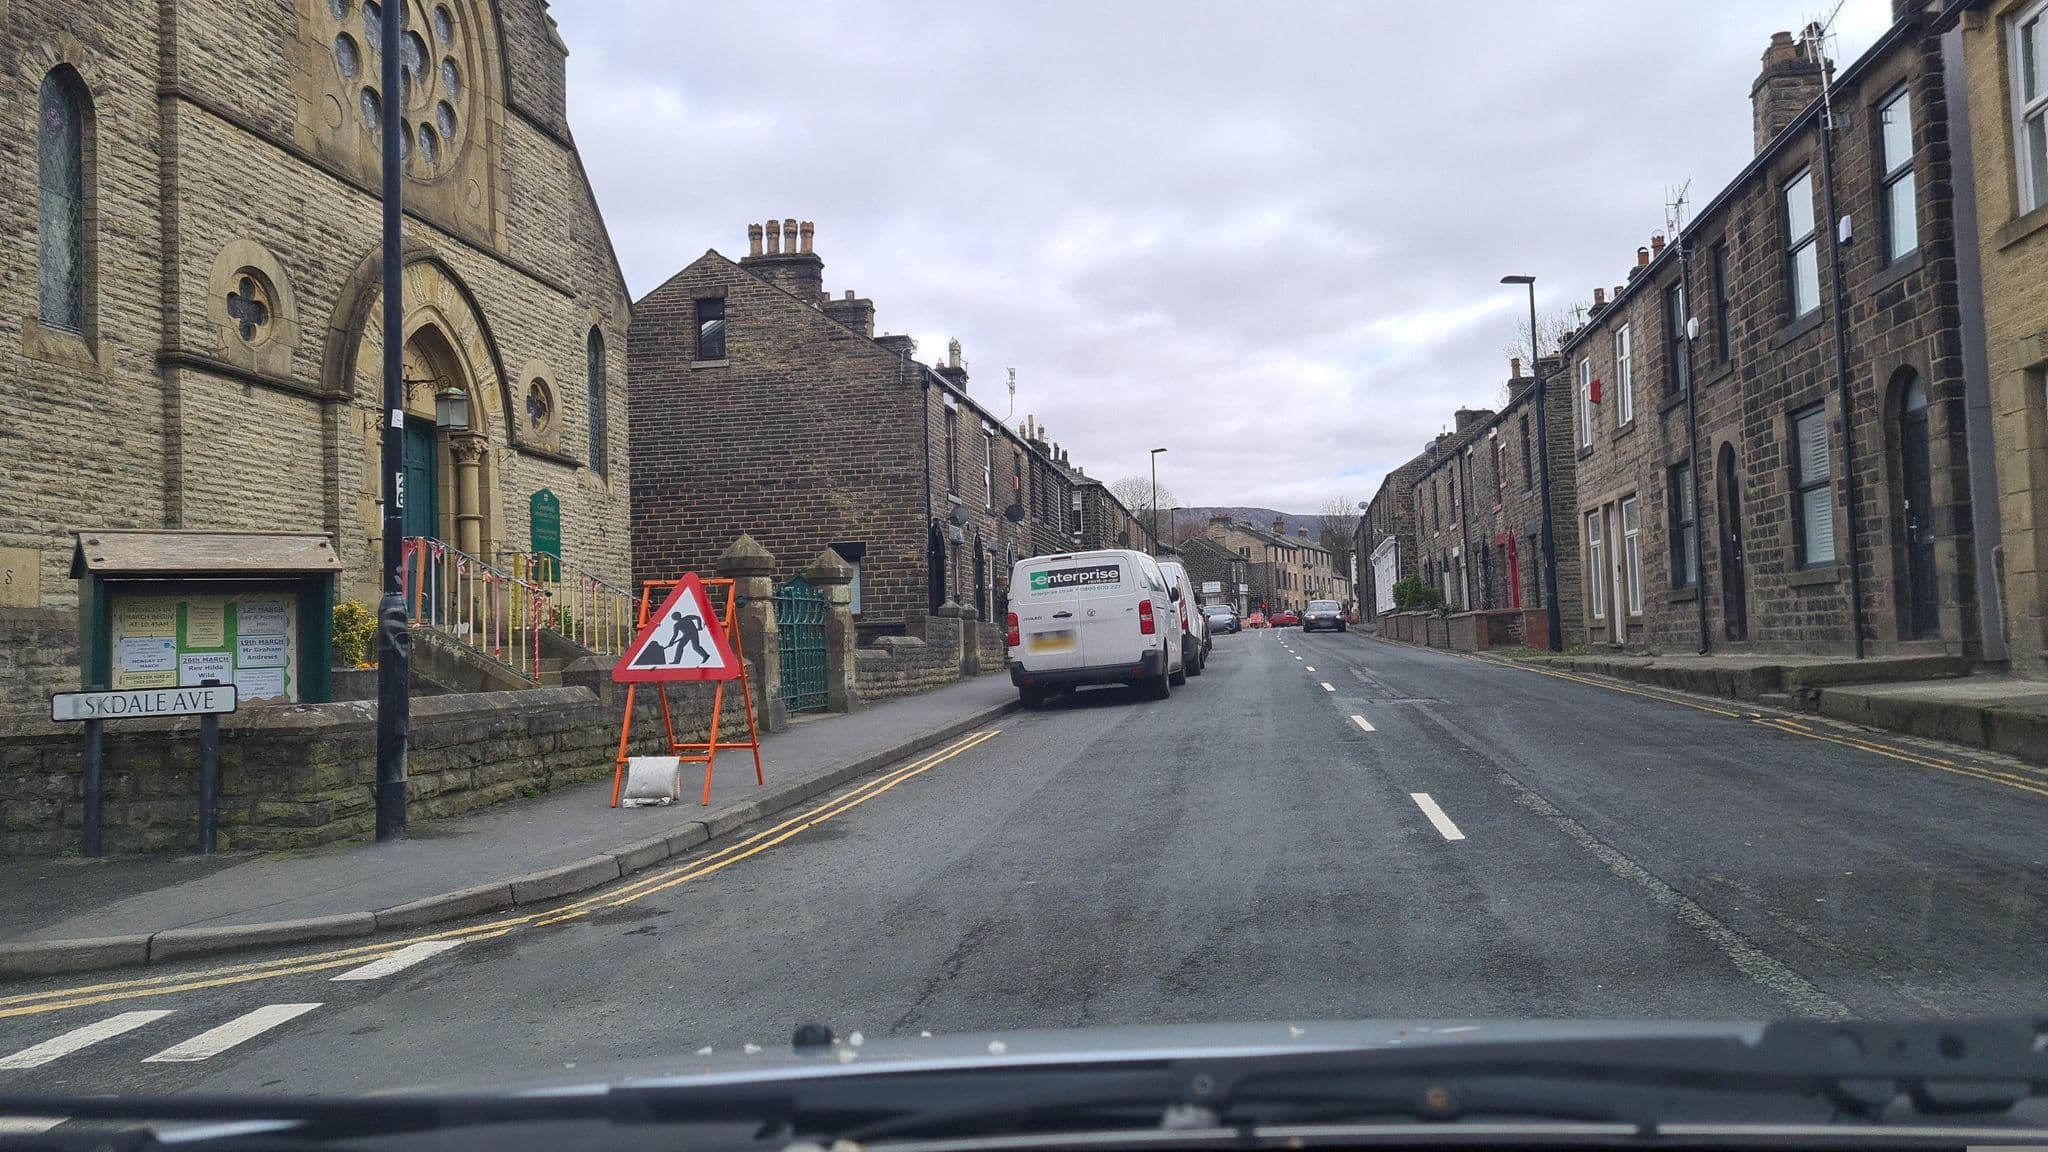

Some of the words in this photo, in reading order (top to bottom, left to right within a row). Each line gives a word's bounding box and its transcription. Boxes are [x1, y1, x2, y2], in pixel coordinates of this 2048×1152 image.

[1031, 569, 1119, 585] enterprise
[72, 694, 167, 716] SKDALE
[172, 690, 215, 712] AVE
